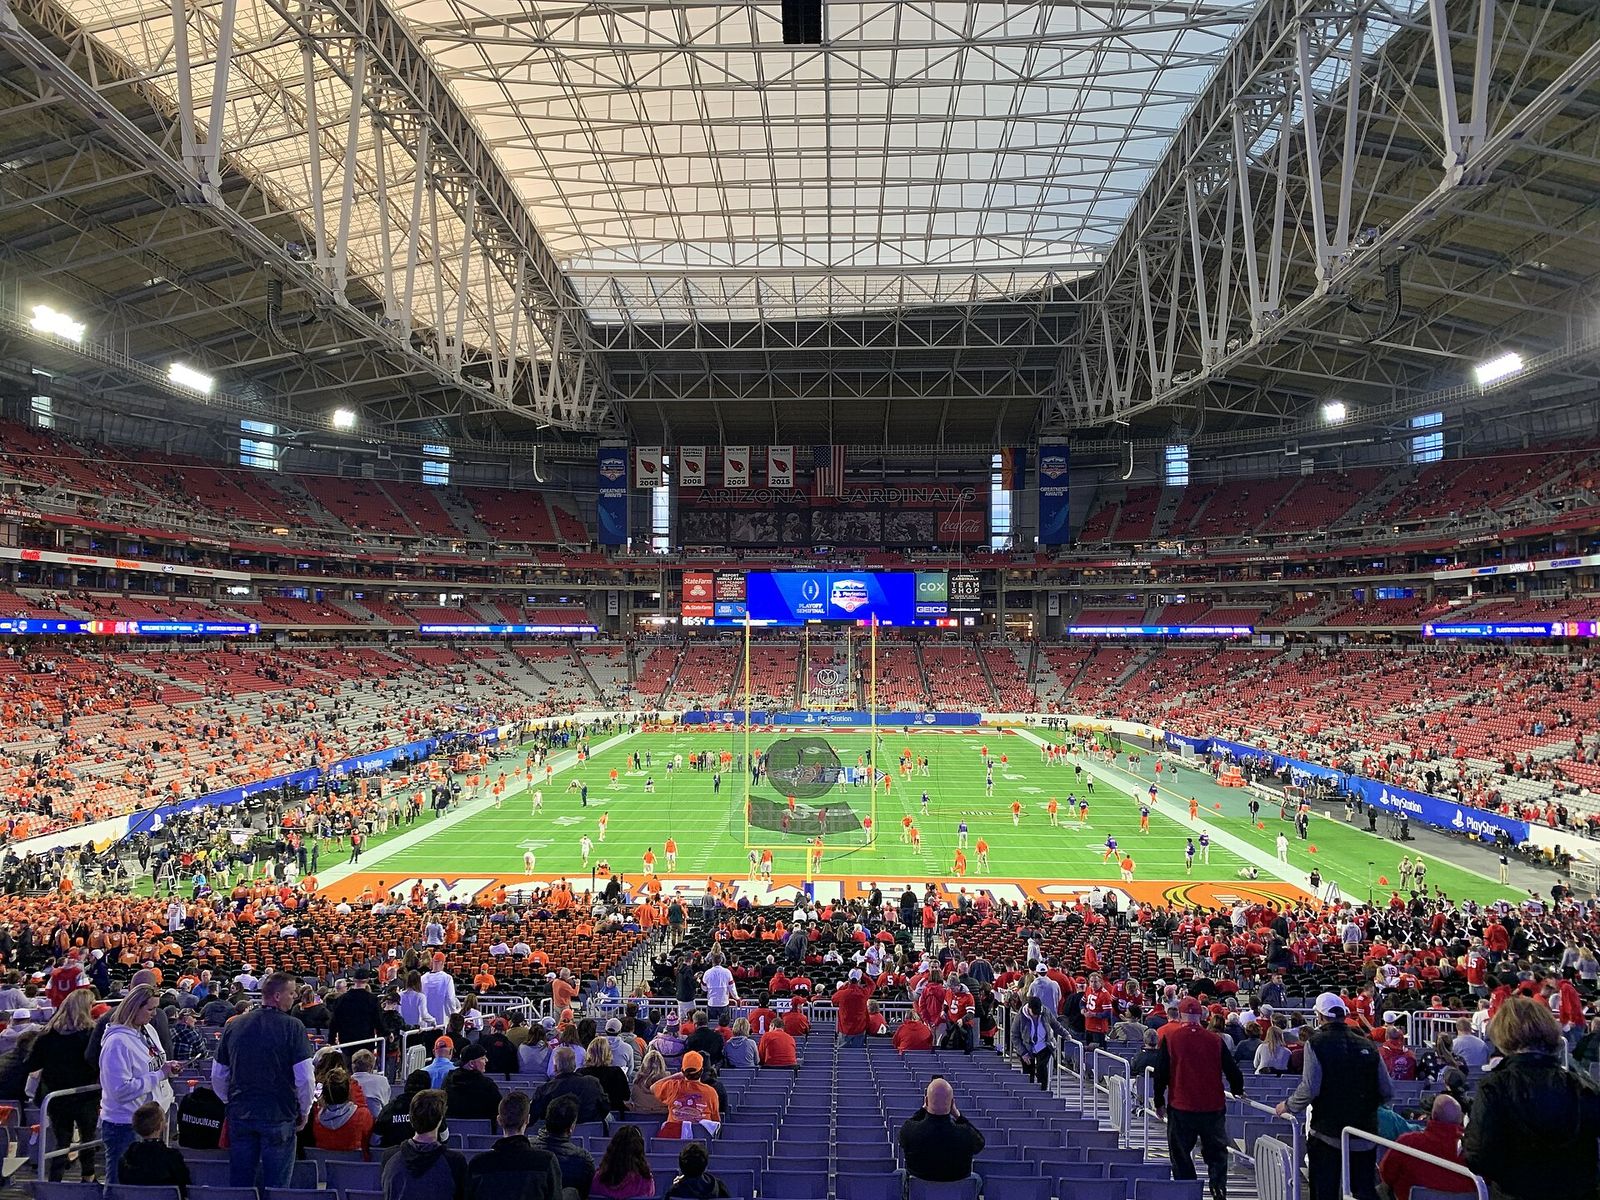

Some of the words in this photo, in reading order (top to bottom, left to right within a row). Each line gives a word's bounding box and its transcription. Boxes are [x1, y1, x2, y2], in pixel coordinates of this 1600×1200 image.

[697, 489, 809, 504] ARIZONA
[835, 487, 977, 503] CARDINALS
[3, 508, 21, 516] LARRY
[22, 511, 42, 519] WILSON
[919, 582, 945, 592] COX
[682, 616, 706, 626] 86:54
[811, 686, 844, 696] Allstate
[1390, 794, 1423, 814] PlayStation
[1466, 816, 1509, 838] PlayStatn
[58, 979, 70, 991] U
[887, 975, 894, 985] 5
[759, 1015, 765, 1035] 1
